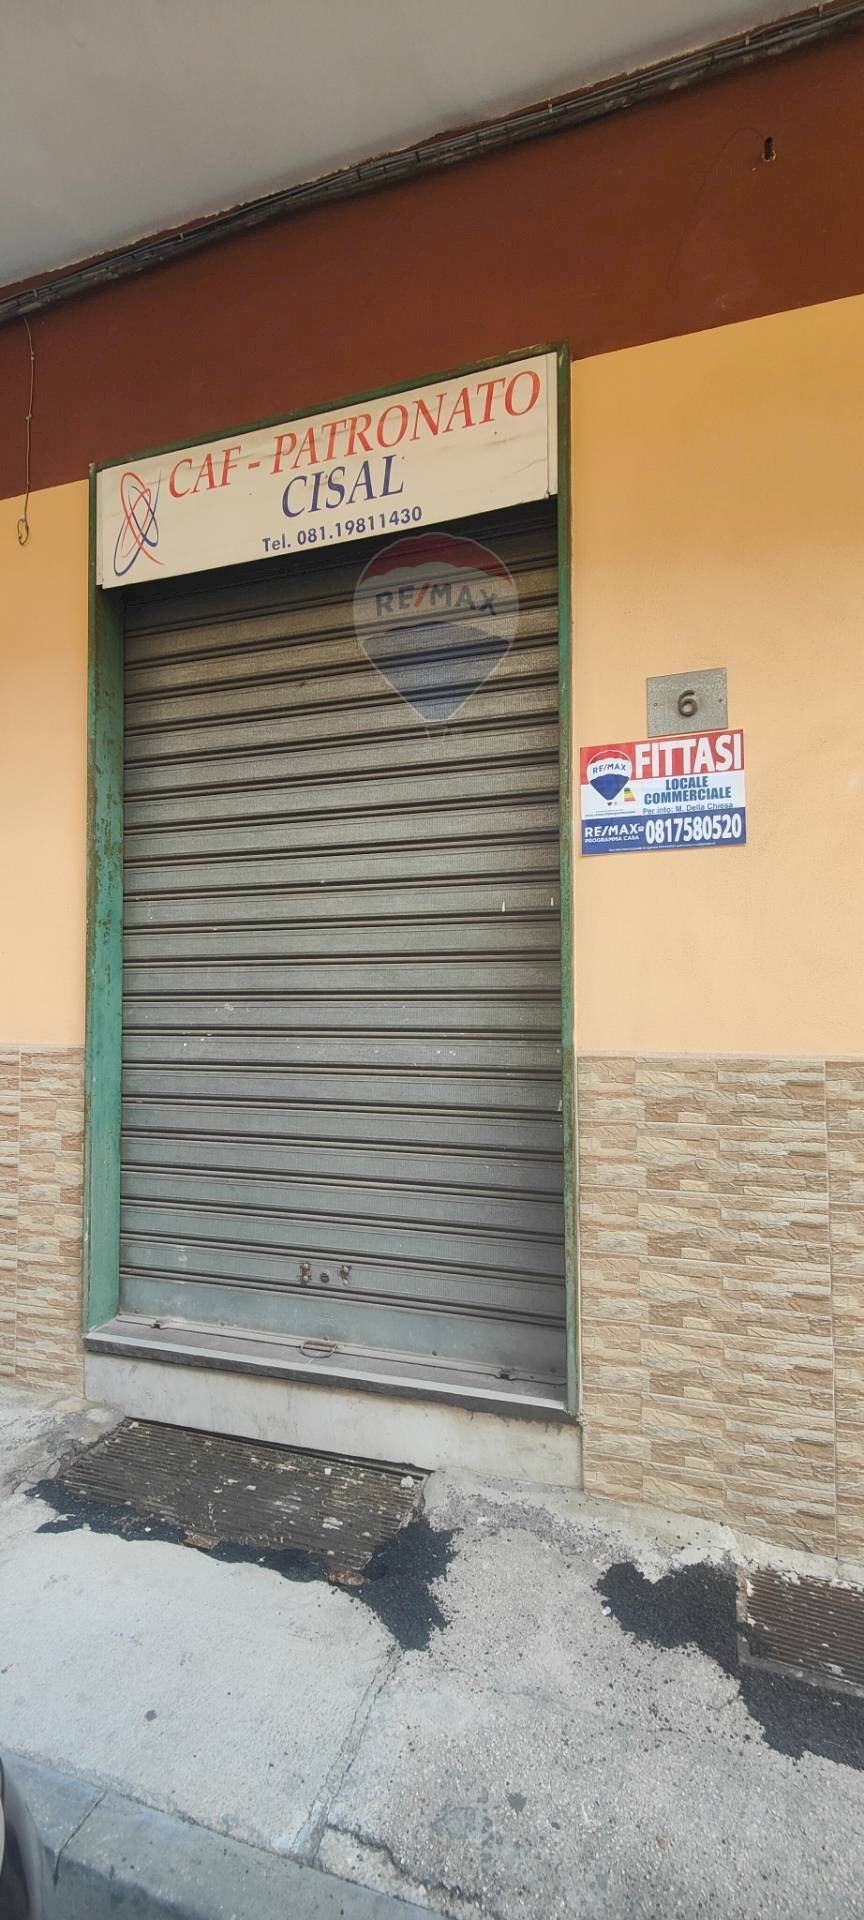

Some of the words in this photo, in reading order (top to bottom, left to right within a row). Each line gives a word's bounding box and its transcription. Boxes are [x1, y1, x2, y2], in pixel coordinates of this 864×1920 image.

[169, 445, 241, 498] CAF
[270, 370, 541, 475] PATRONATO
[282, 453, 405, 518] CISAL
[262, 534, 292, 553] Tel.
[297, 505, 423, 546] 081.19811430
[678, 690, 698, 717] 6
[592, 763, 626, 775] RE/MAX
[635, 733, 742, 779] FITTASI
[644, 787, 732, 805] COMMERCIALE
[665, 776, 709, 791] LOCALE
[657, 805, 673, 814] info:
[687, 803, 705, 811] Della
[707, 801, 734, 810] Chiesa
[585, 824, 639, 838] RE/MAX
[645, 813, 742, 845] 0817580520
